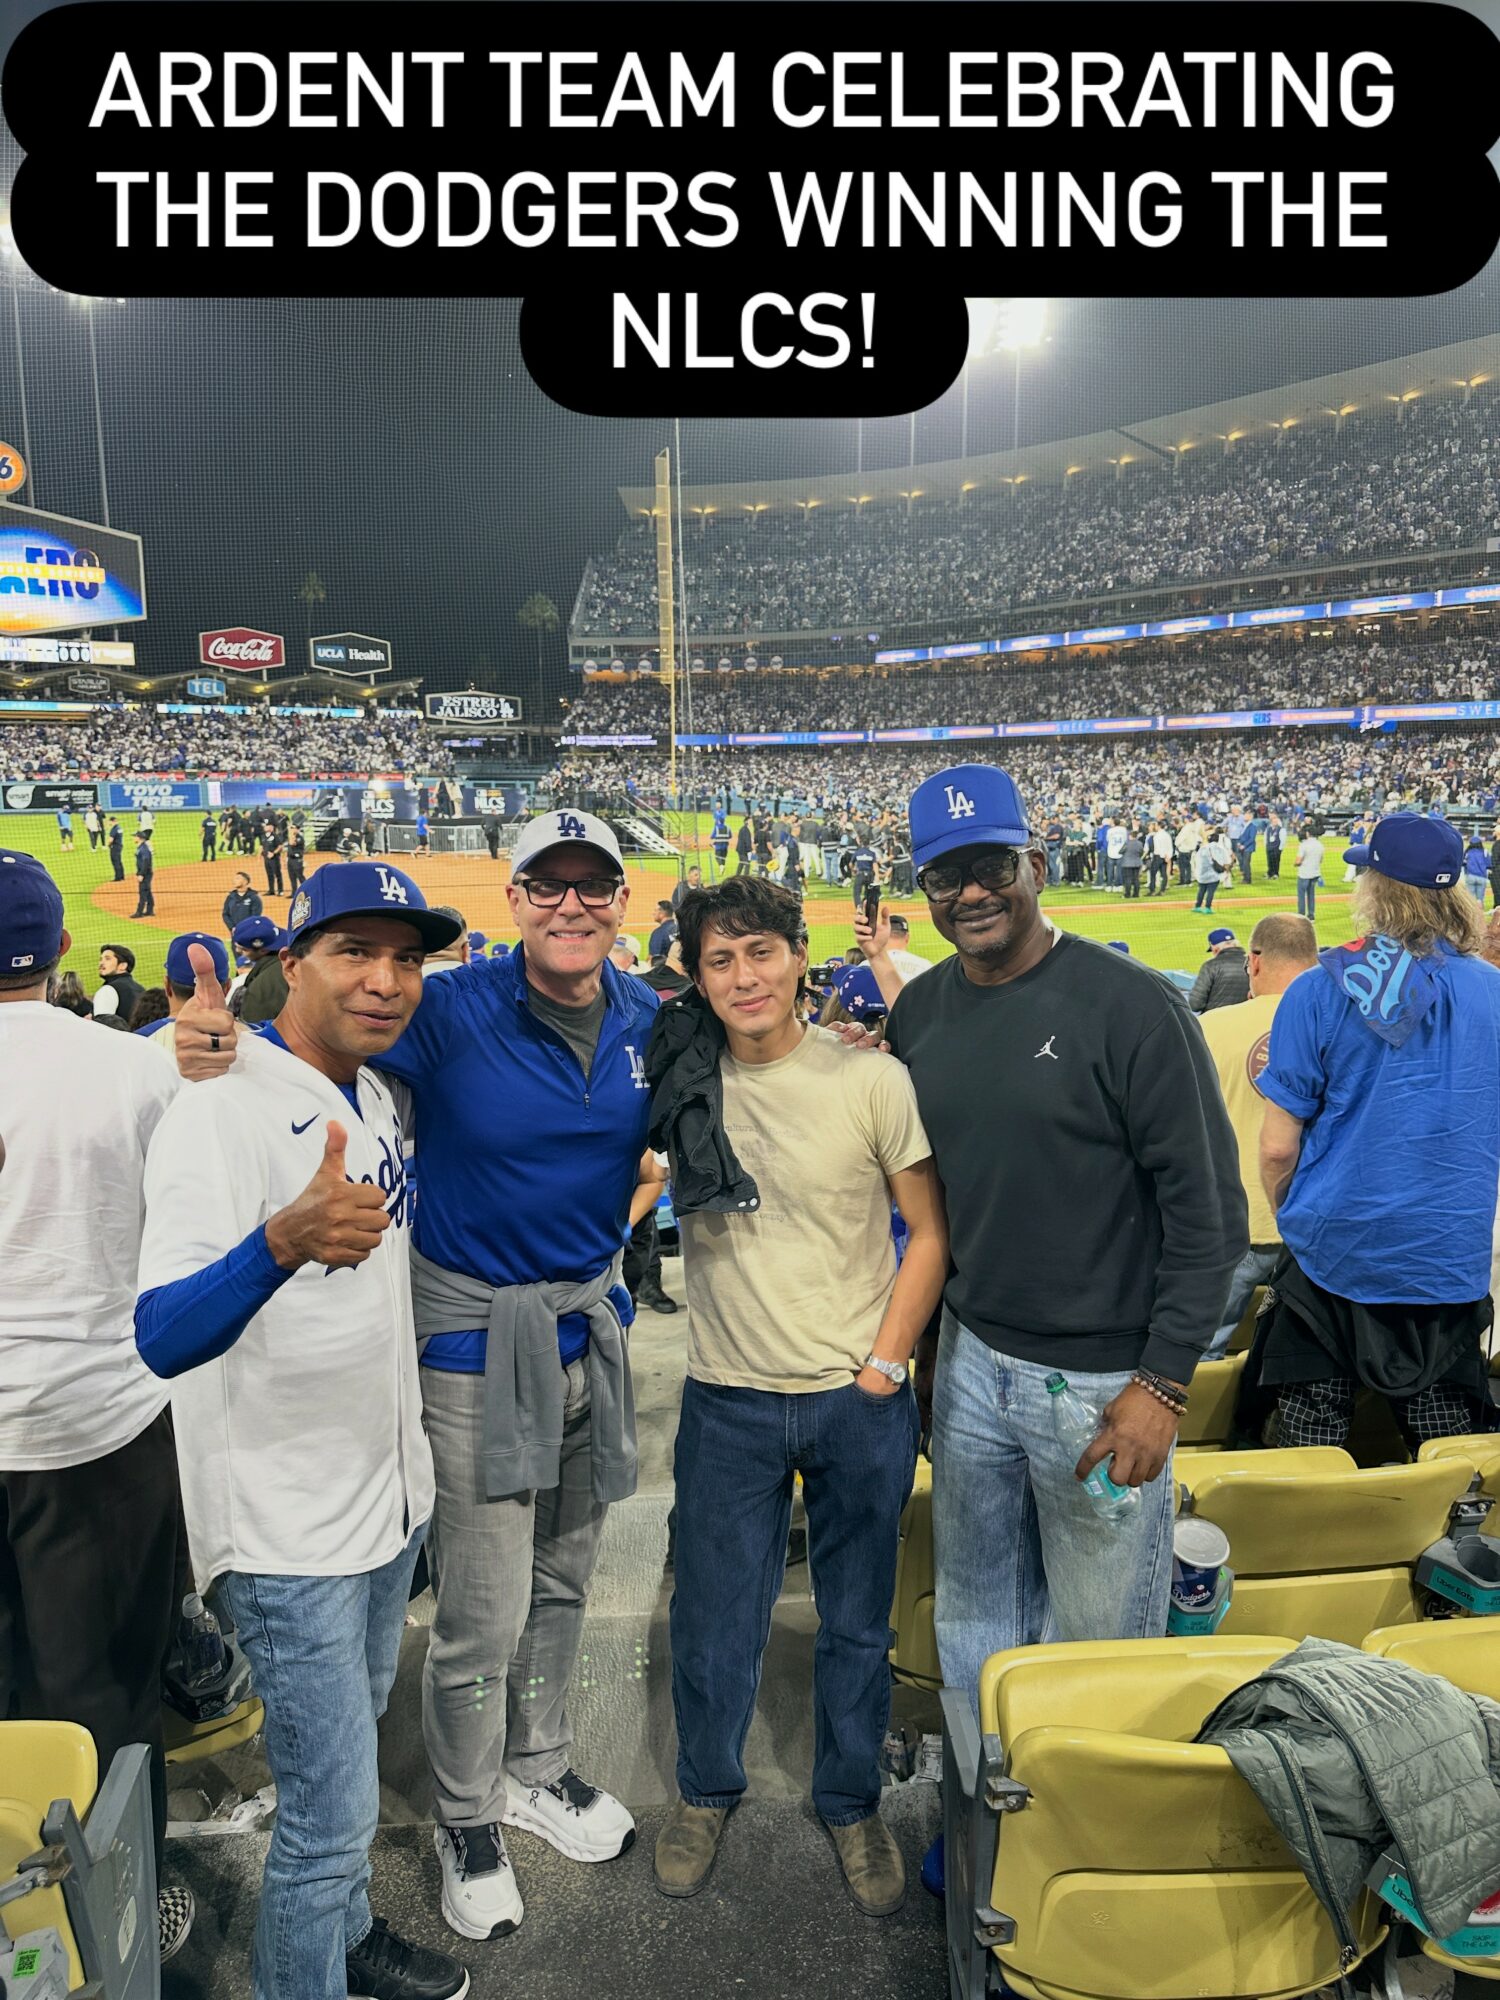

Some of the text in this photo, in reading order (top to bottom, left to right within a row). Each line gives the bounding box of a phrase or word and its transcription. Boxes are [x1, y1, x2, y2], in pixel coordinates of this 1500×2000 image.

[317, 647, 386, 662] UCLA Health
[192, 681, 224, 694] TEL
[435, 705, 498, 719] JALISCO
[122, 785, 172, 796] TOYO
[131, 796, 185, 807] TIRES
[360, 798, 396, 813] NLCS
[474, 796, 506, 809] NLCS
[944, 785, 976, 820] LA
[557, 813, 586, 838] LA
[374, 867, 409, 905] LA
[1173, 1589, 1211, 1606] Dodgers
